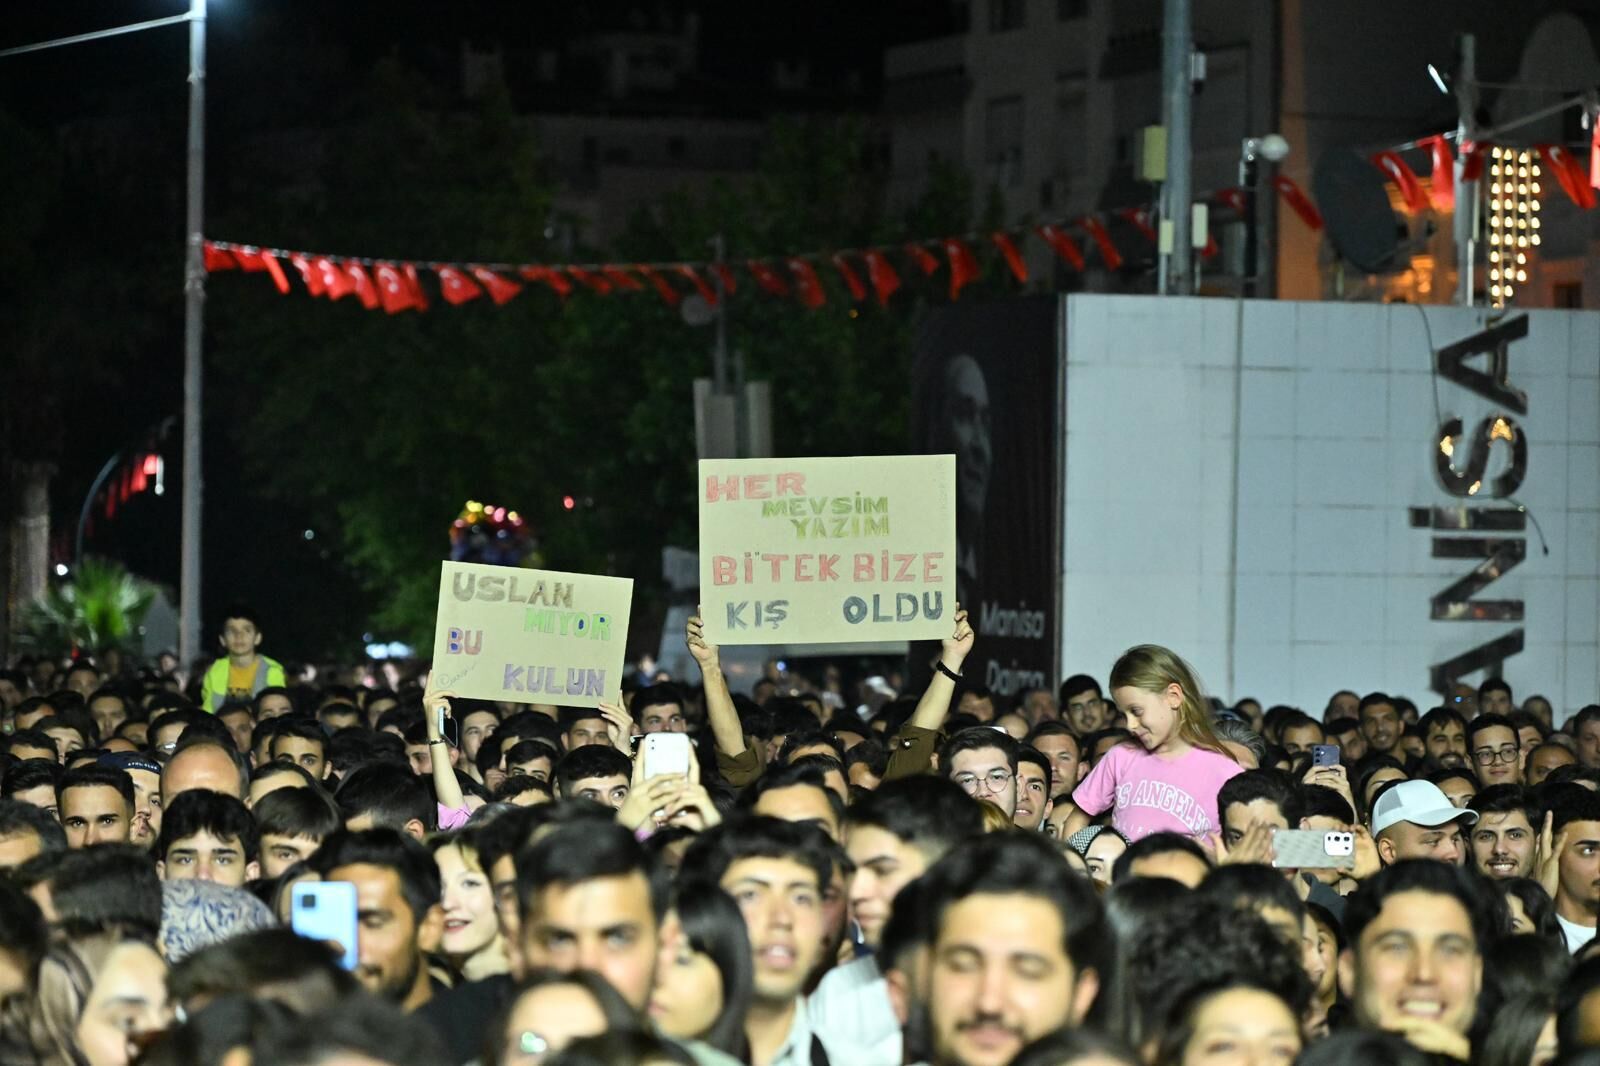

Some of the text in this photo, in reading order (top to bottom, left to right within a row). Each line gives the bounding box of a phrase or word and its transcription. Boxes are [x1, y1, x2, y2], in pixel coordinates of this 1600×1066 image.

[706, 472, 806, 503] HER
[761, 491, 889, 517] MEVSİM
[790, 515, 890, 539] YAZIM
[853, 550, 945, 583] BİZE
[453, 572, 575, 608] USLAN
[726, 590, 944, 630] KIŞ OLDU
[980, 600, 1045, 638] Manisa
[446, 627, 483, 655] BU
[502, 663, 606, 697] KULUN
